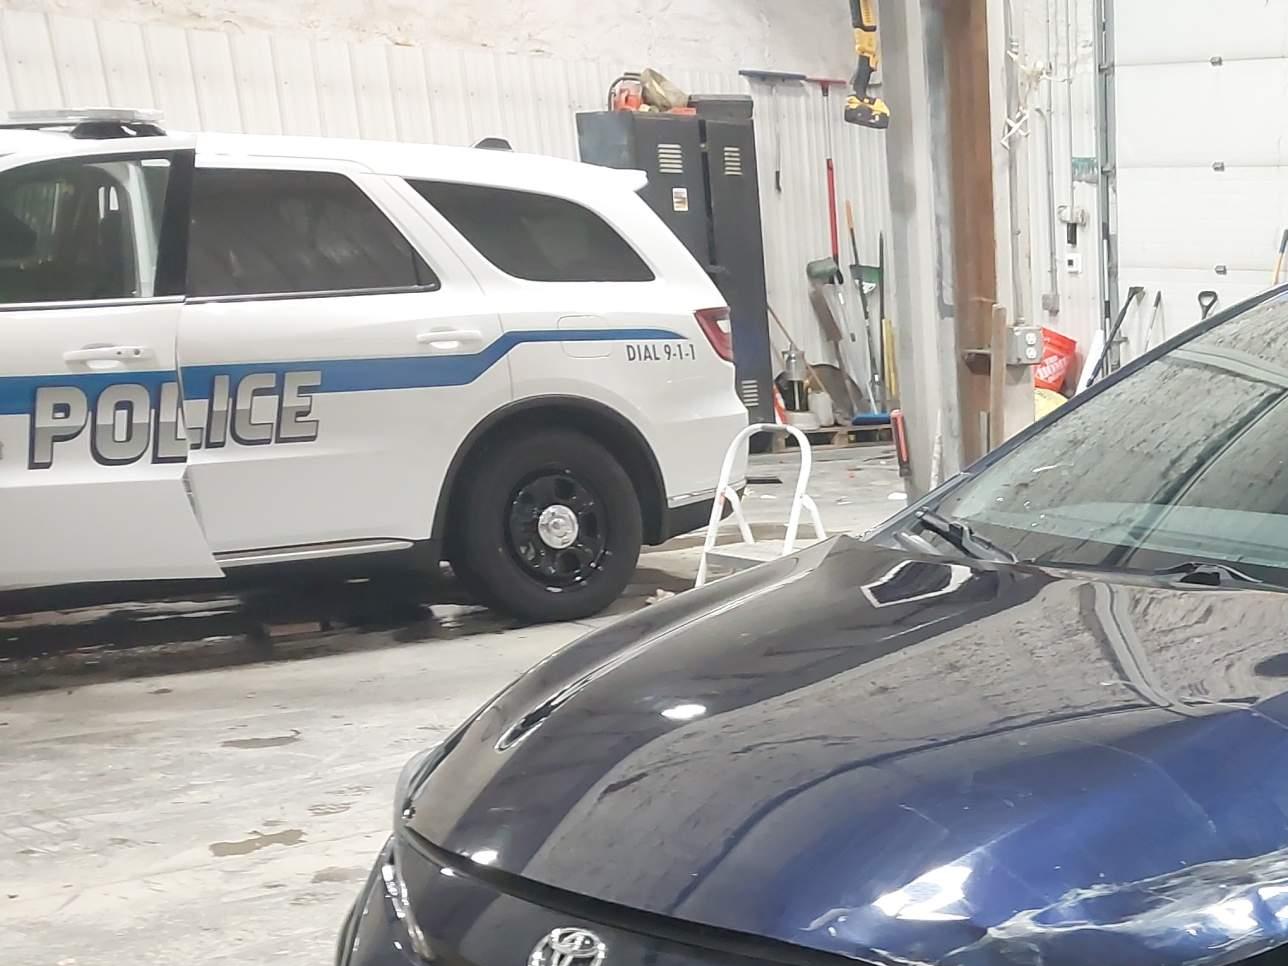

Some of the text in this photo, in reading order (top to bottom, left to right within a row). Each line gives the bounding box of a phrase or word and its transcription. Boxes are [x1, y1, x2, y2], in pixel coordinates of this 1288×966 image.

[626, 343, 696, 361] DIAL 9-1-1
[28, 370, 322, 470] POLICE
